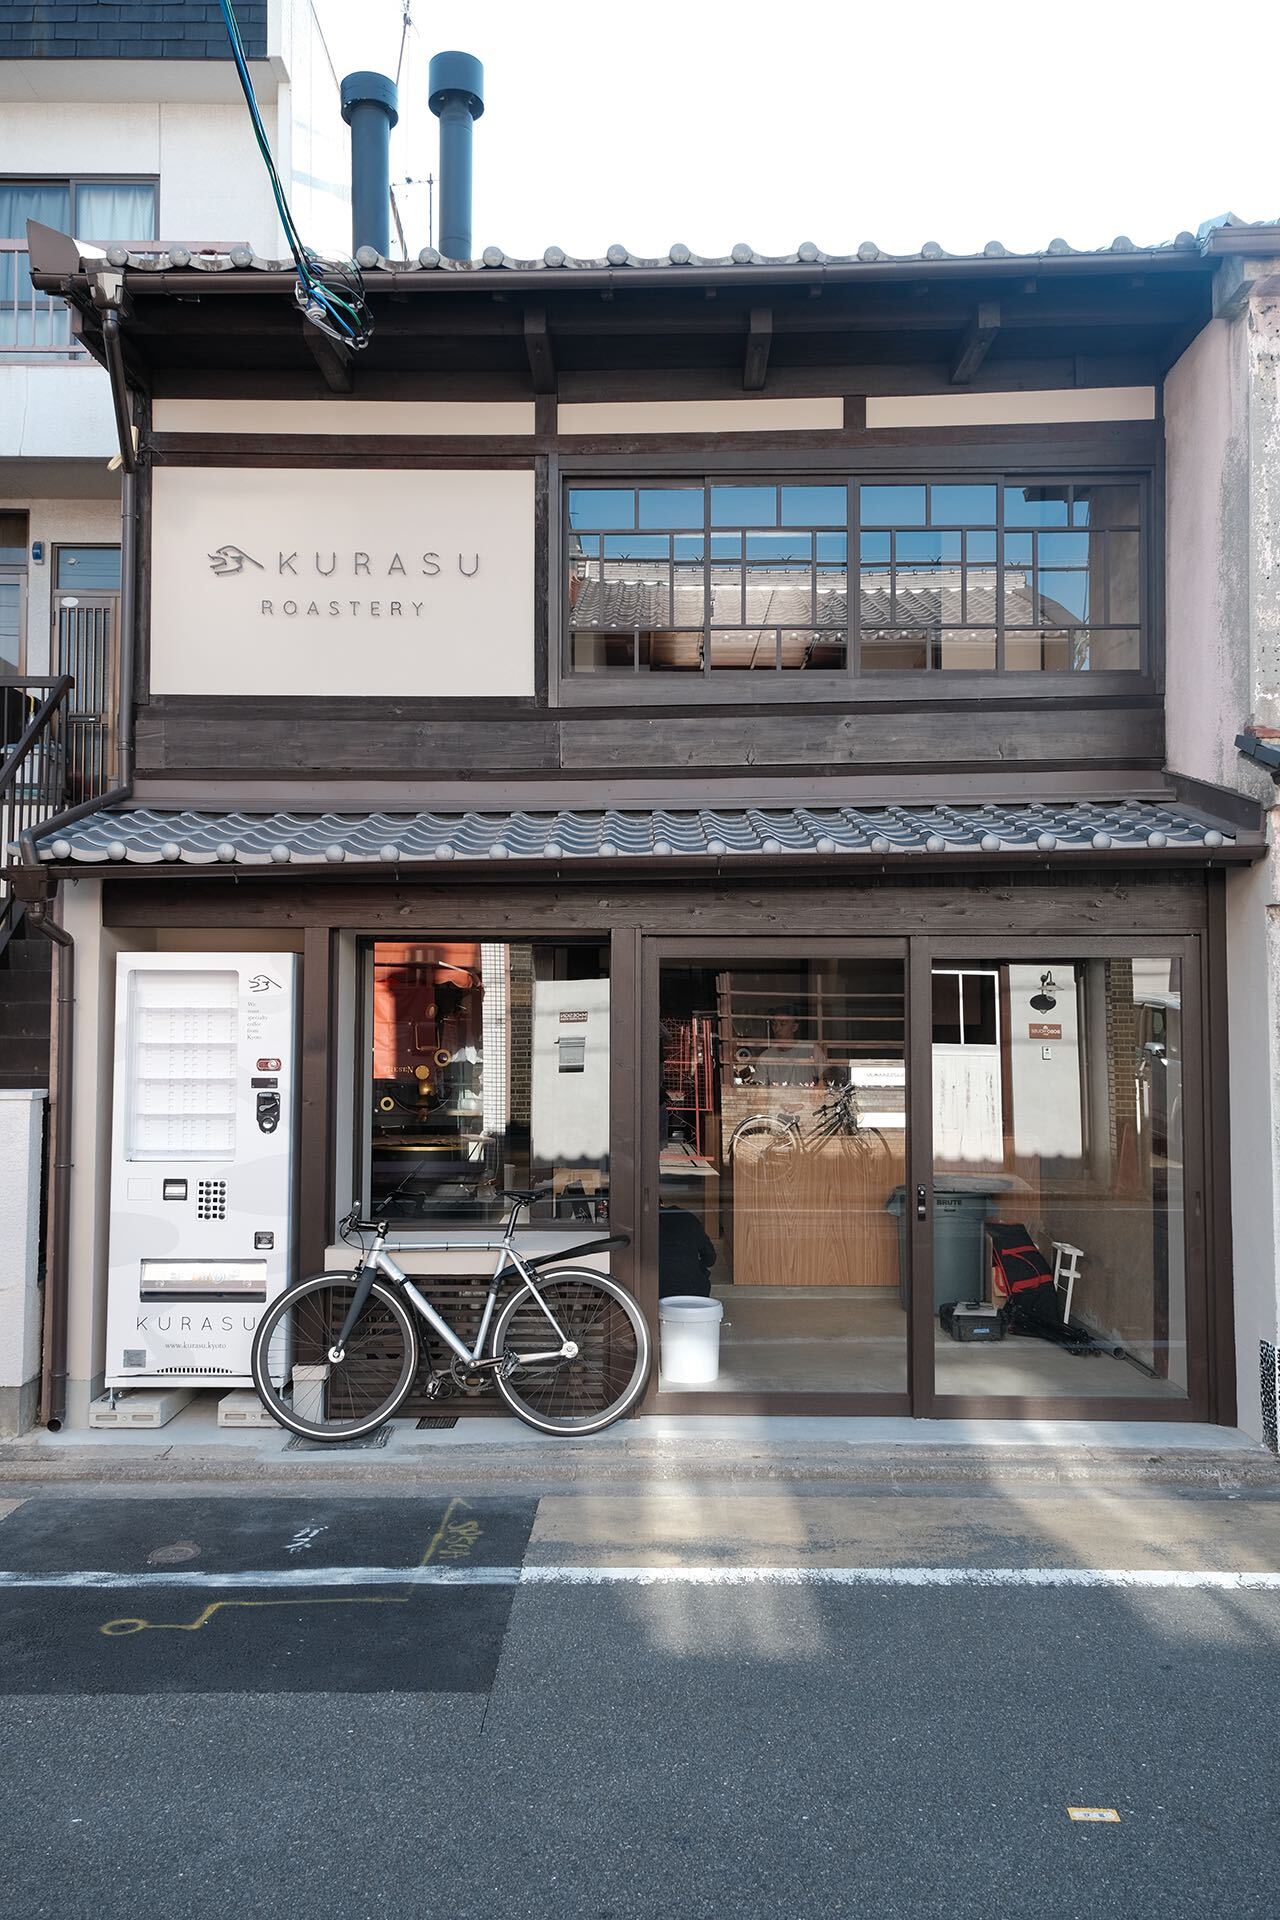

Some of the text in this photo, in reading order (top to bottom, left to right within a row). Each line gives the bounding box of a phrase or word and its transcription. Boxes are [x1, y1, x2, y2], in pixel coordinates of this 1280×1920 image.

[279, 551, 480, 577] KURASU
[261, 599, 424, 616] ROASTERY
[136, 1316, 256, 1331] KURASU
[164, 1341, 227, 1350] www.kurasu.kyoto
